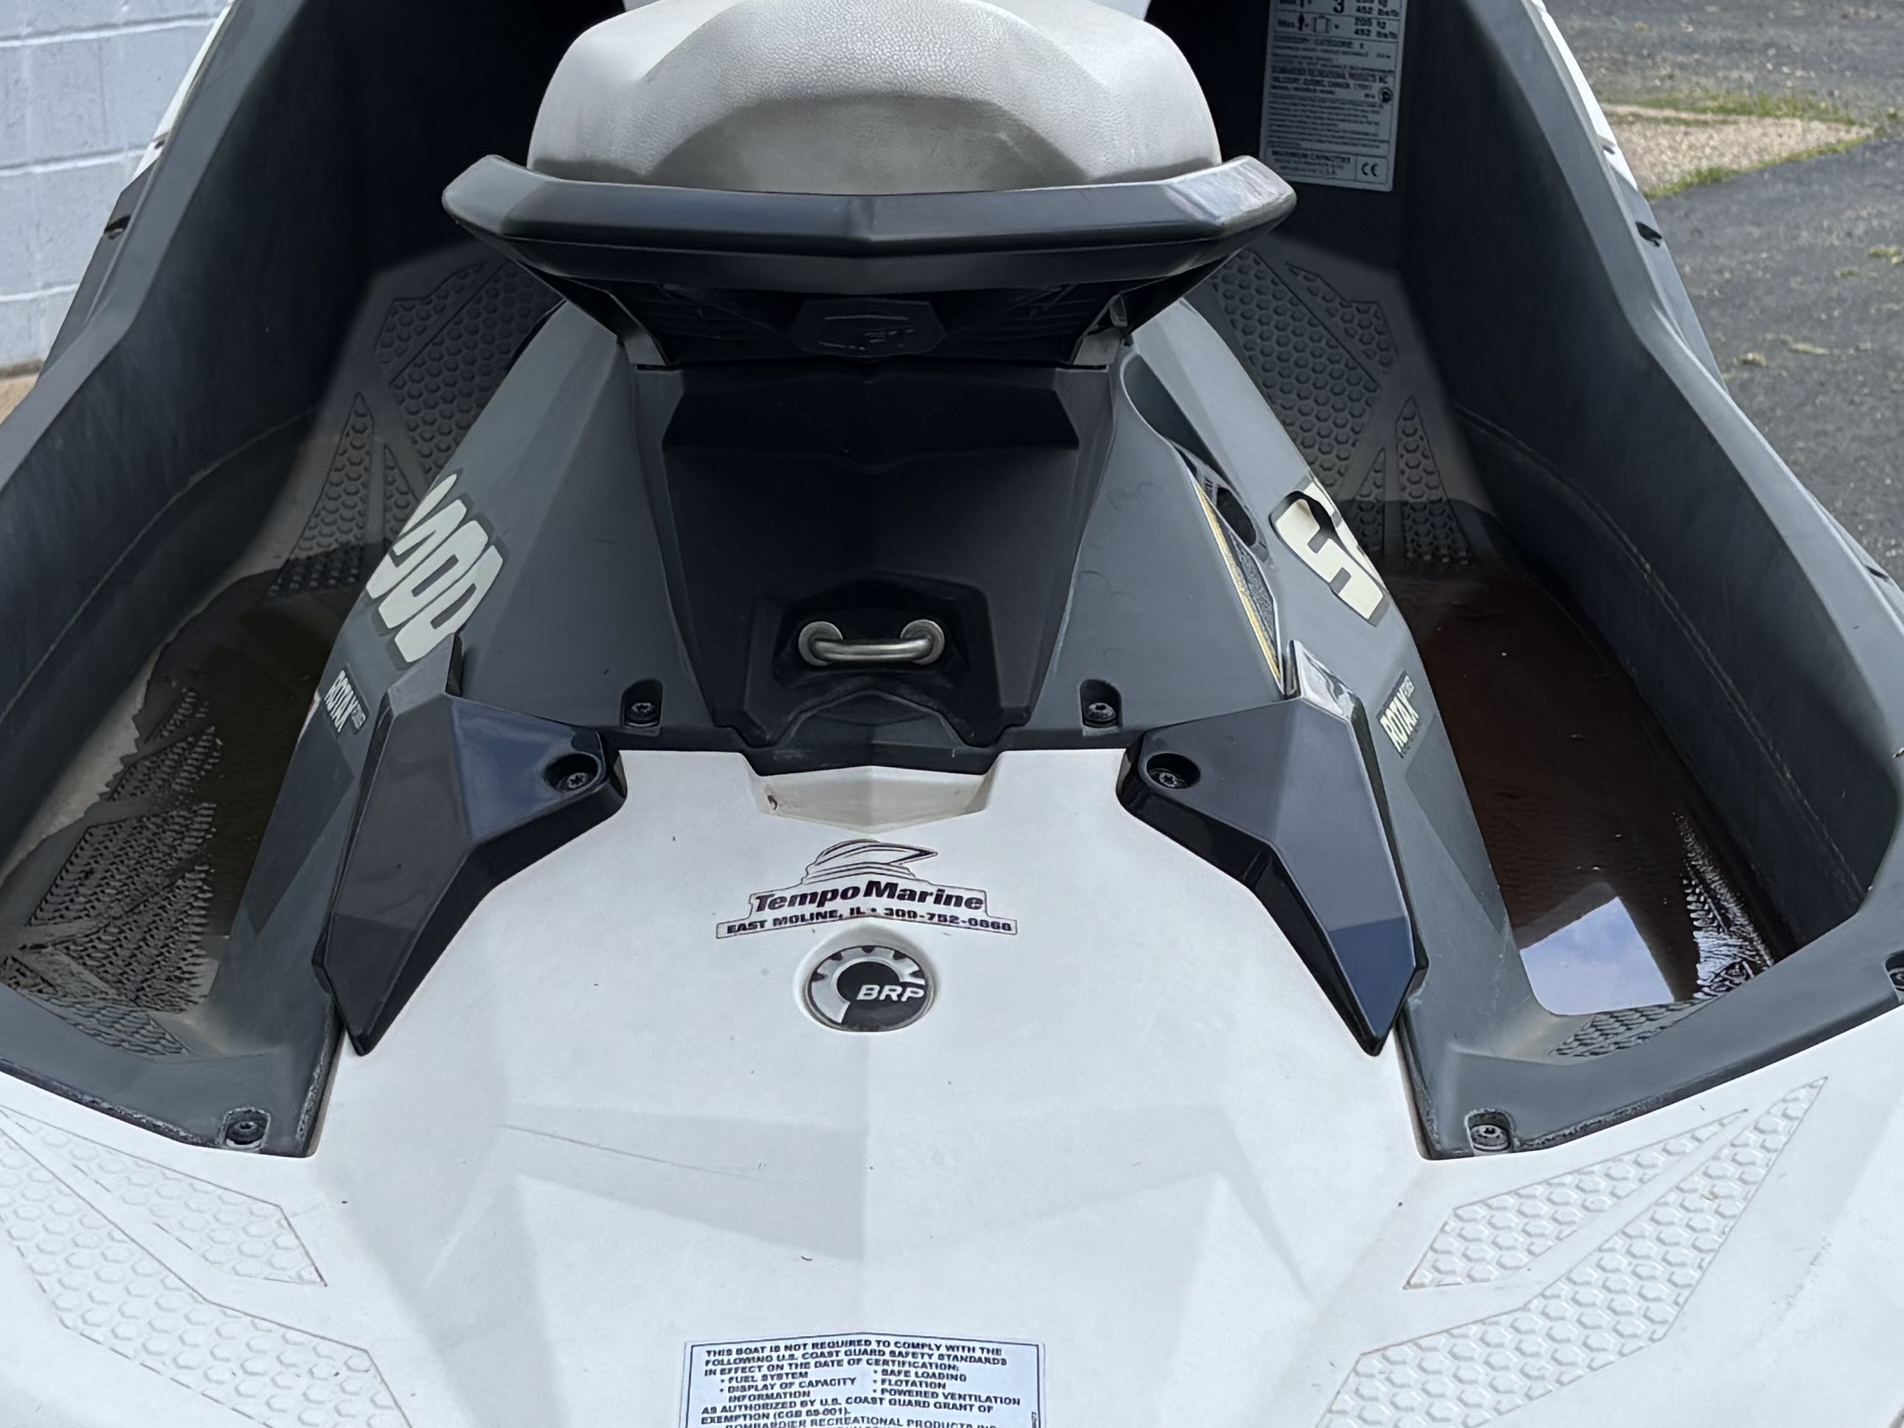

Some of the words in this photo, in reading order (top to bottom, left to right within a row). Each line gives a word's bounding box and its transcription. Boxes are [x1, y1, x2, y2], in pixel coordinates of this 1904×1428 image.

[726, 920, 767, 934] EAST
[856, 984, 925, 1002] BRP
[736, 1347, 766, 1356] BOAT
[784, 1343, 808, 1352] NOT
[812, 1340, 872, 1350] REQUIRED
[875, 1339, 890, 1348] TO
[894, 1341, 942, 1352] COMPLY
[979, 1347, 1002, 1356] THE
[767, 1363, 784, 1372] ON
[788, 1361, 811, 1370] THE
[814, 1359, 844, 1369] DATE
[881, 1388, 939, 1399] POWERED
[942, 1392, 1021, 1405] VENTILATION
[810, 1416, 903, 1426] RECREATIONAL
